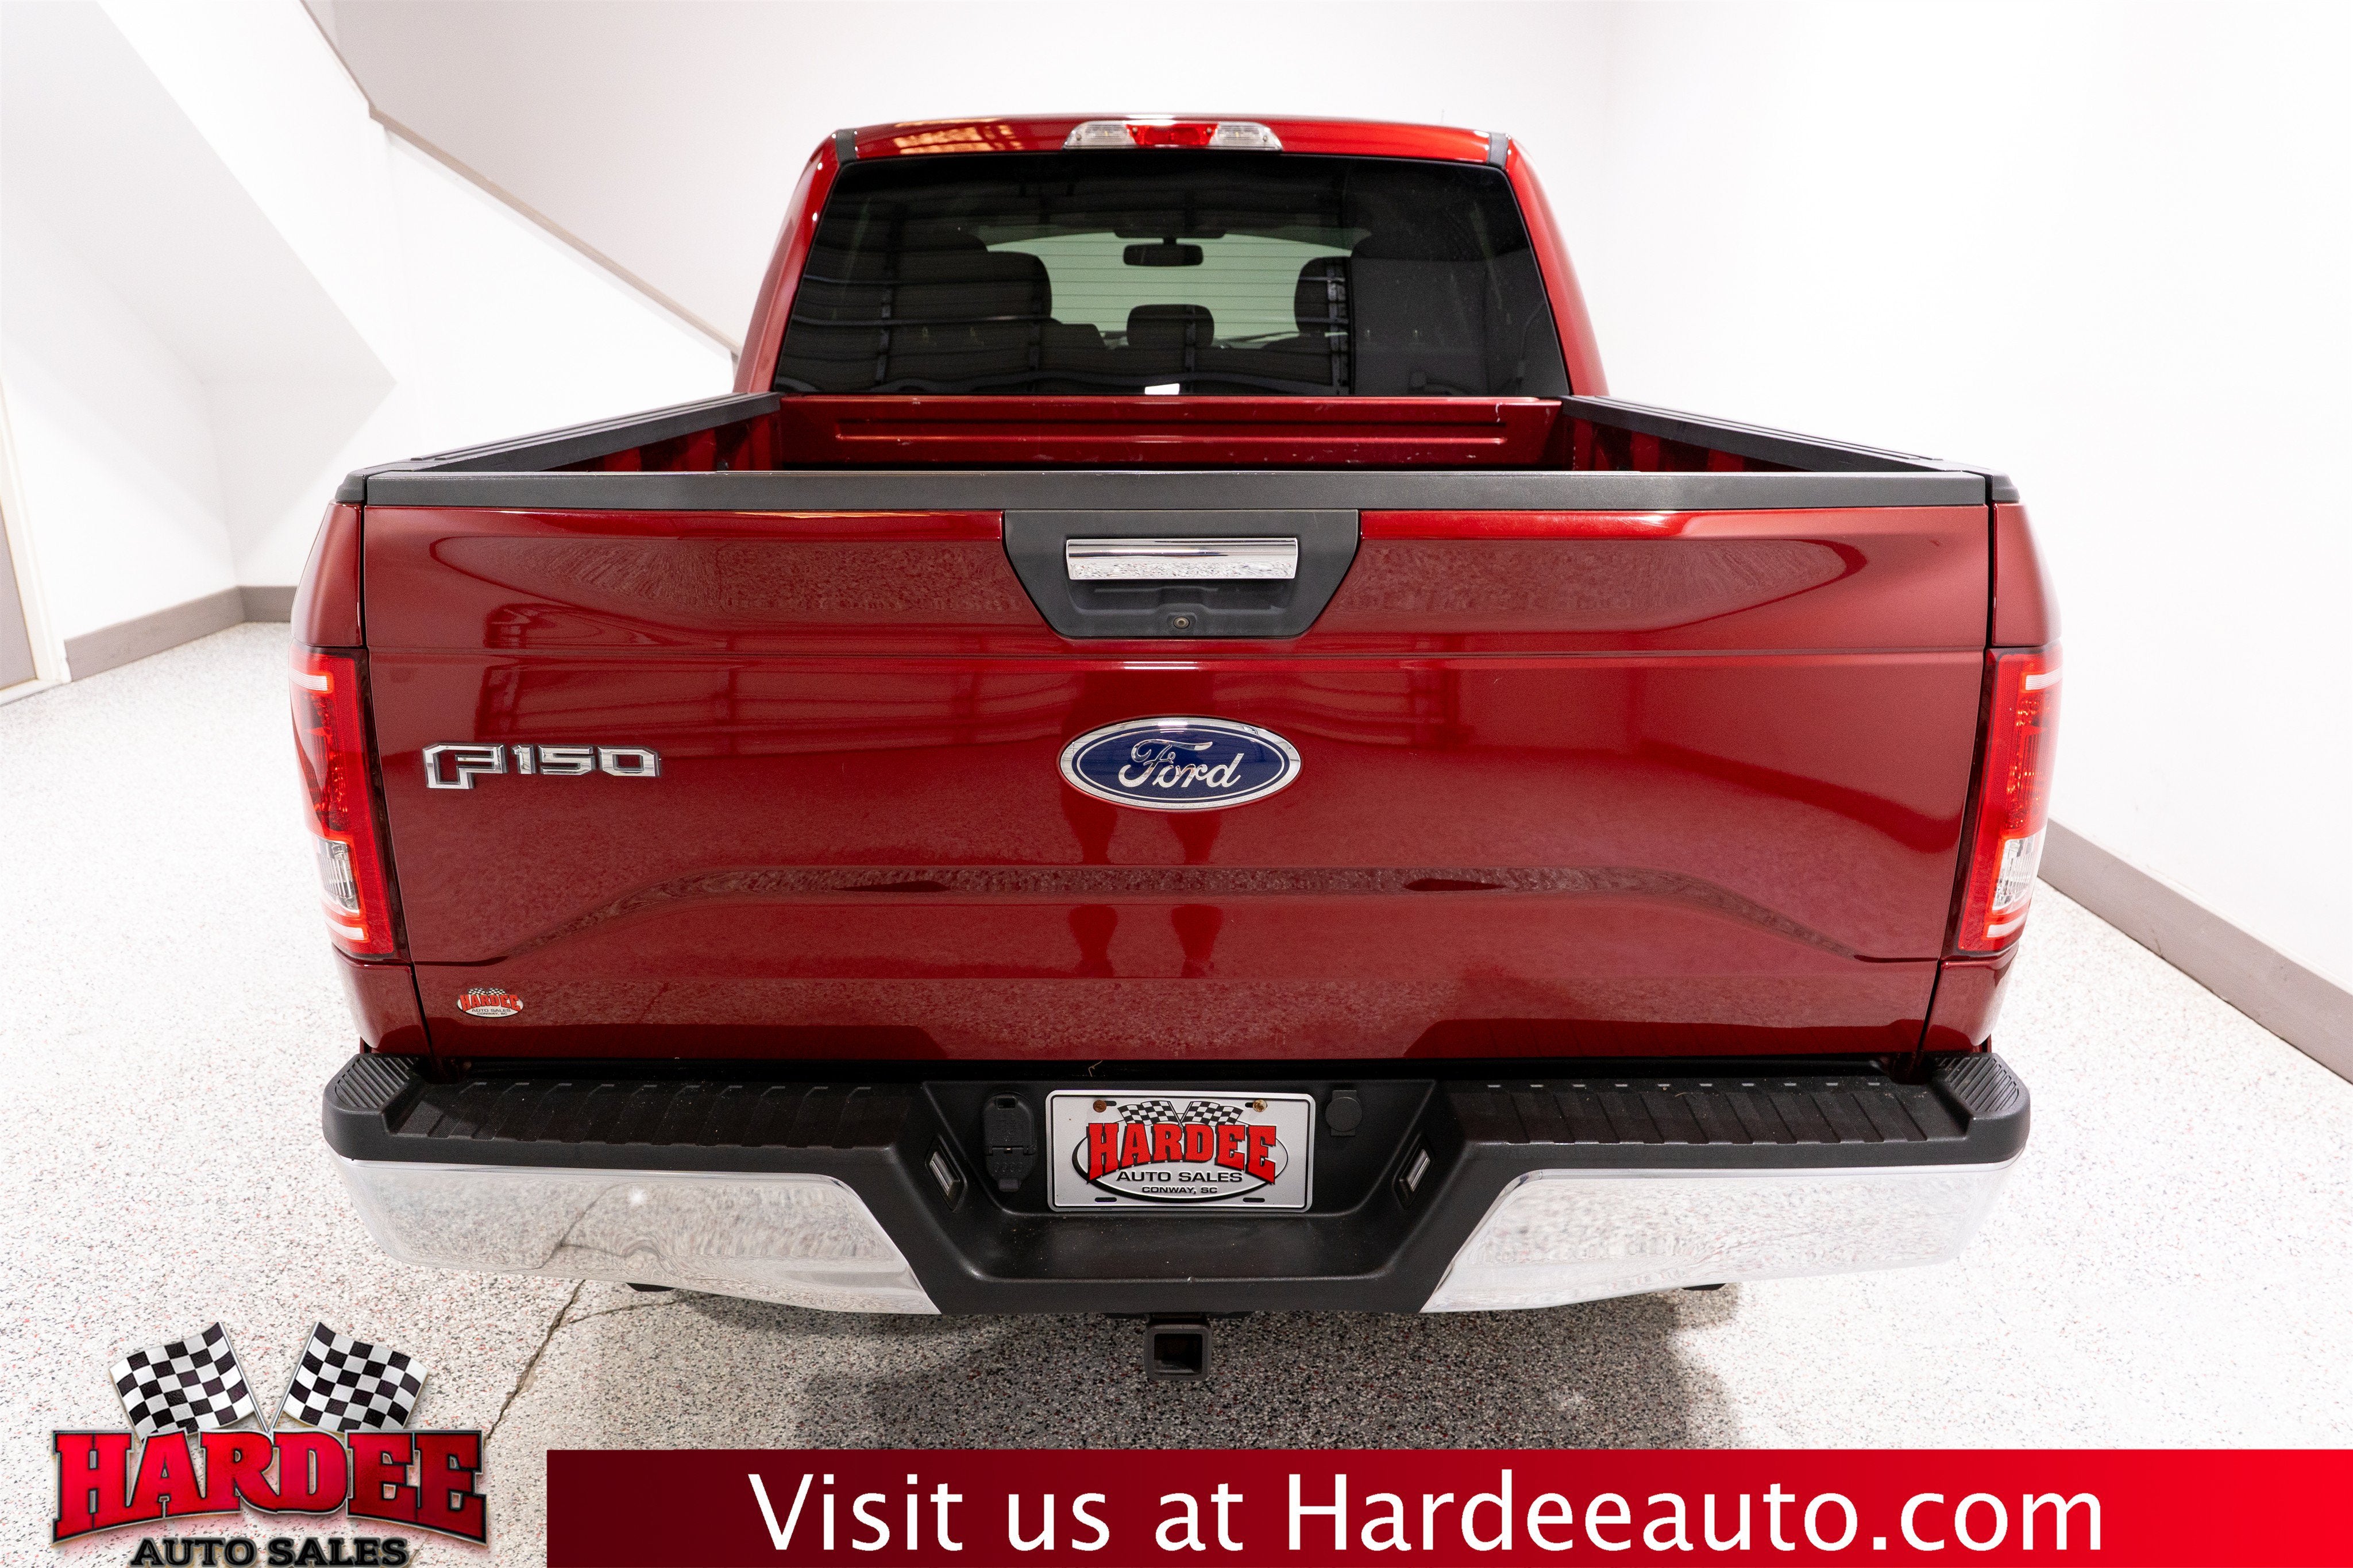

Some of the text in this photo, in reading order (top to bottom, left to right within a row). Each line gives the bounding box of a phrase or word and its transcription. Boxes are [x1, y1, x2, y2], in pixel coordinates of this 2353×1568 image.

[1118, 739, 1241, 788] Ford
[460, 994, 521, 1011] HARDEE
[1086, 1122, 1276, 1185] HARDEE
[1116, 1171, 1243, 1183] AUTO SALES
[1141, 1186, 1197, 1195] CONWAY,
